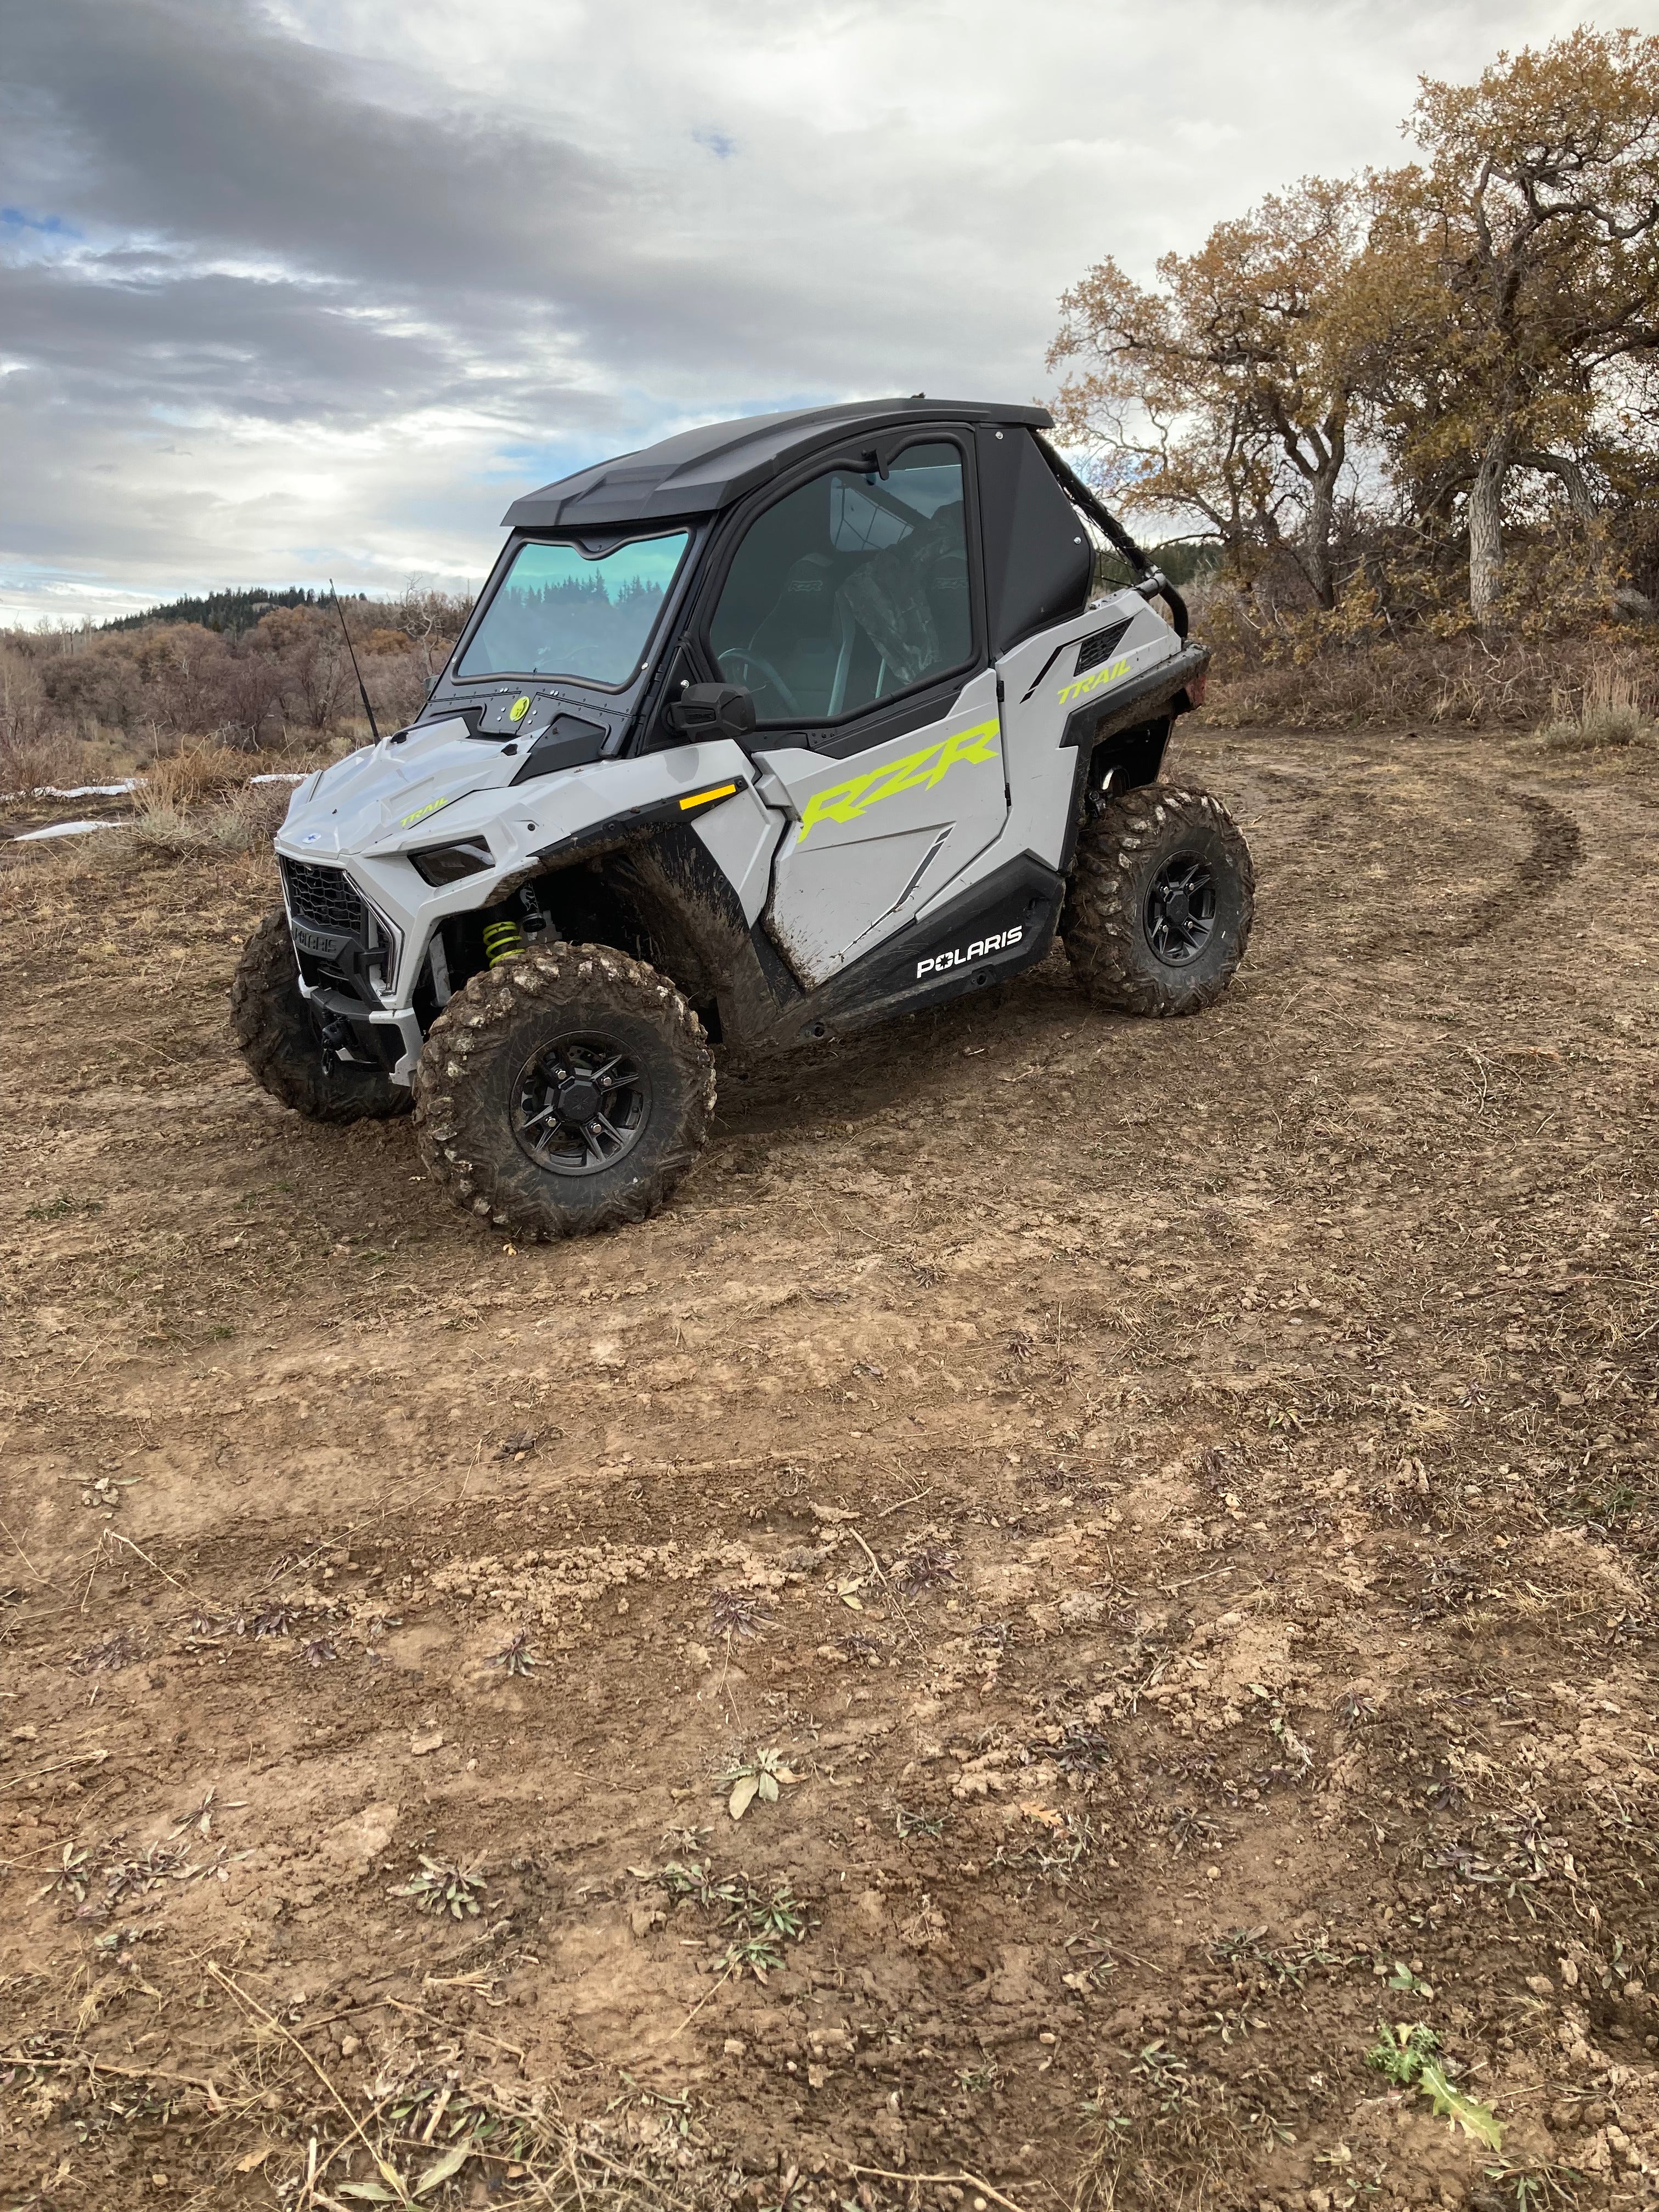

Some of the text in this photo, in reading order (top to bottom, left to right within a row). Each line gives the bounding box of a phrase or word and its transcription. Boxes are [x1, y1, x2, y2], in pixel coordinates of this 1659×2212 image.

[788, 580, 823, 592] RZR
[1057, 659, 1131, 704] TRAIL
[797, 718, 1000, 844] RZR
[400, 797, 448, 826] TRAIL
[295, 928, 338, 953] POLARIS
[917, 926, 1023, 979] POLARIS
